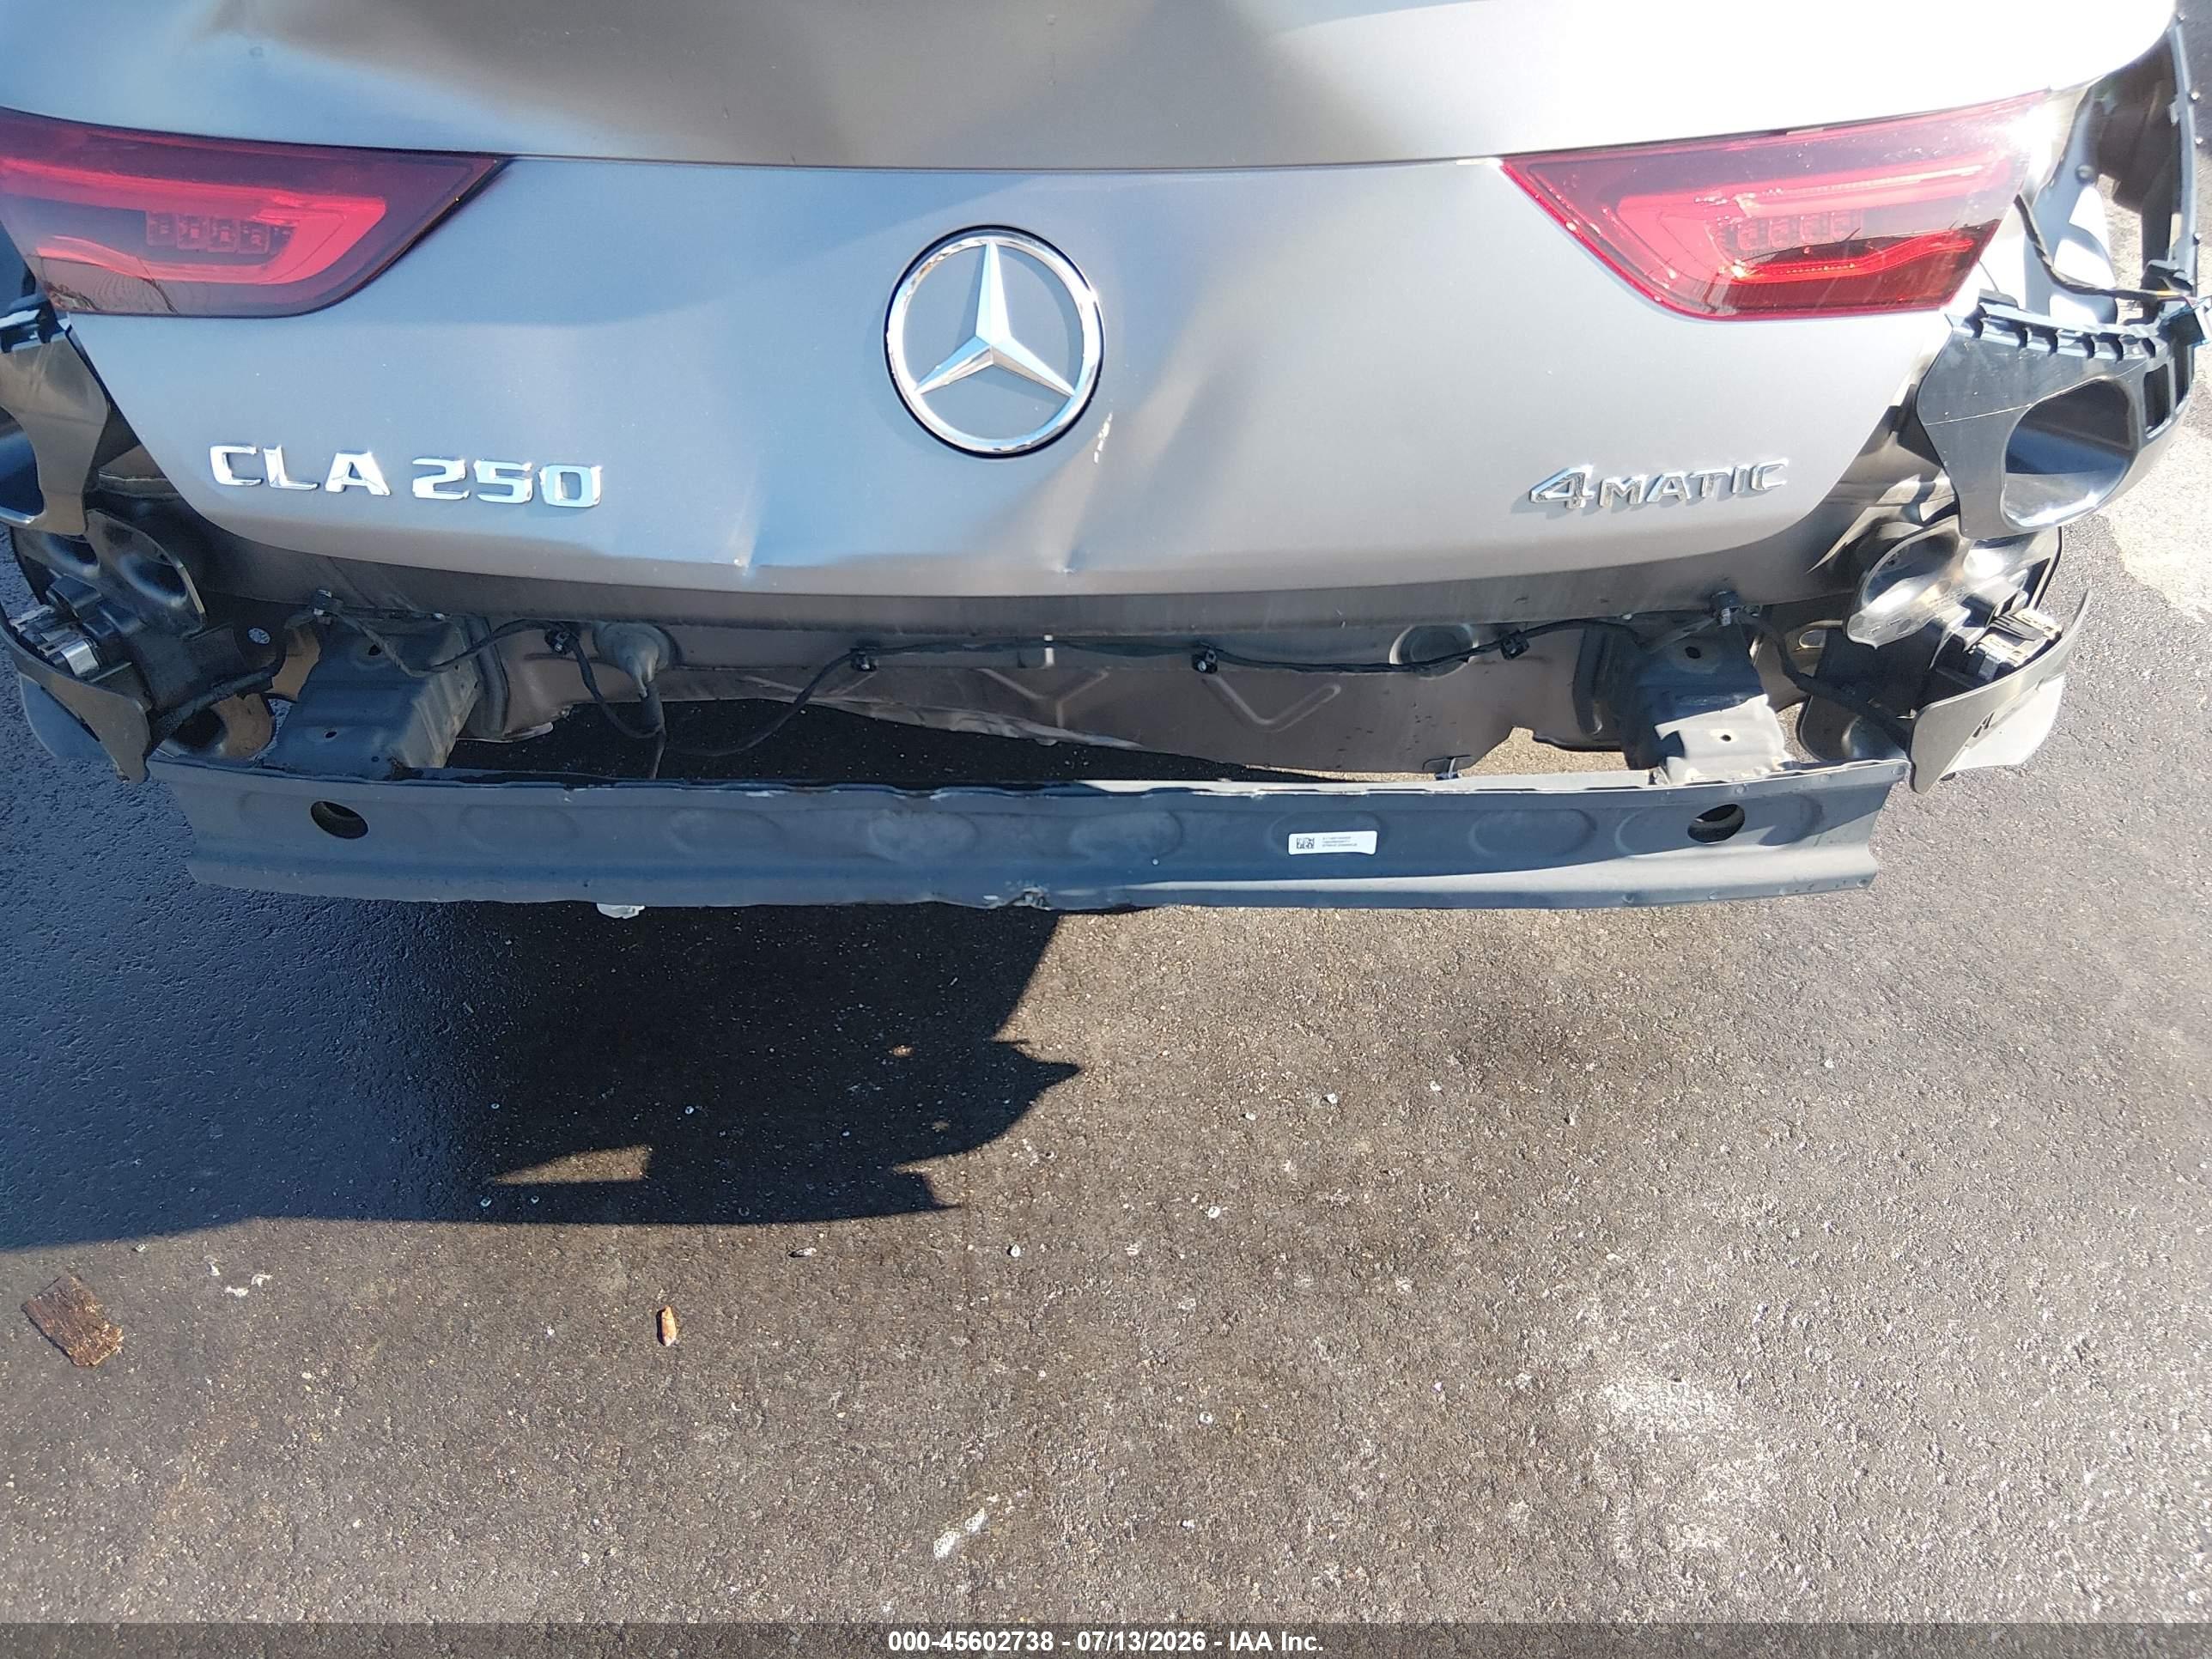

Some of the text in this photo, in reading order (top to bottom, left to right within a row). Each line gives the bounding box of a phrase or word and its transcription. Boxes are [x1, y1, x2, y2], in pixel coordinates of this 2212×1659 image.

[210, 444, 604, 508] CLA 250
[1528, 458, 1790, 509] 4MATIC
